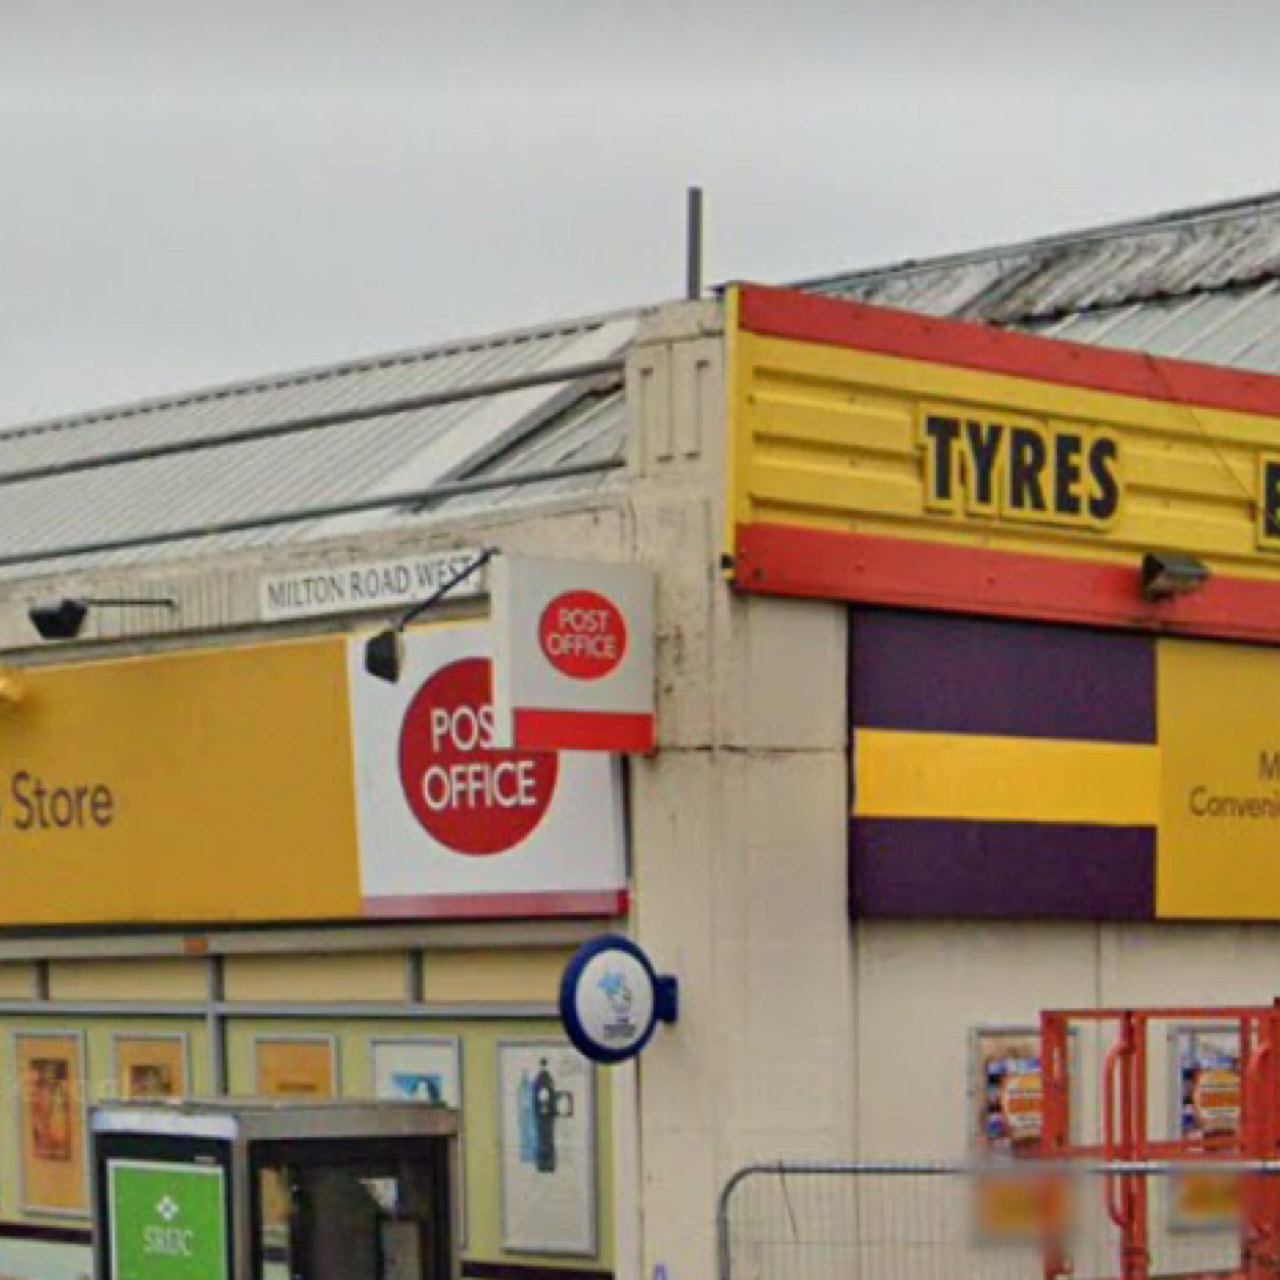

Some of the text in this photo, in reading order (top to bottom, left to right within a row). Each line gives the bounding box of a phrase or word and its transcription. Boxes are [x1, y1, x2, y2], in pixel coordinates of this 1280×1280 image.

[925, 415, 1119, 521] TYRES
[267, 554, 473, 608] MILTON ROAD WEST
[558, 608, 609, 631] POST
[545, 633, 618, 661] OFFICE
[431, 706, 494, 752] POS
[11, 771, 113, 831] Store
[422, 760, 537, 811] OFFICE
